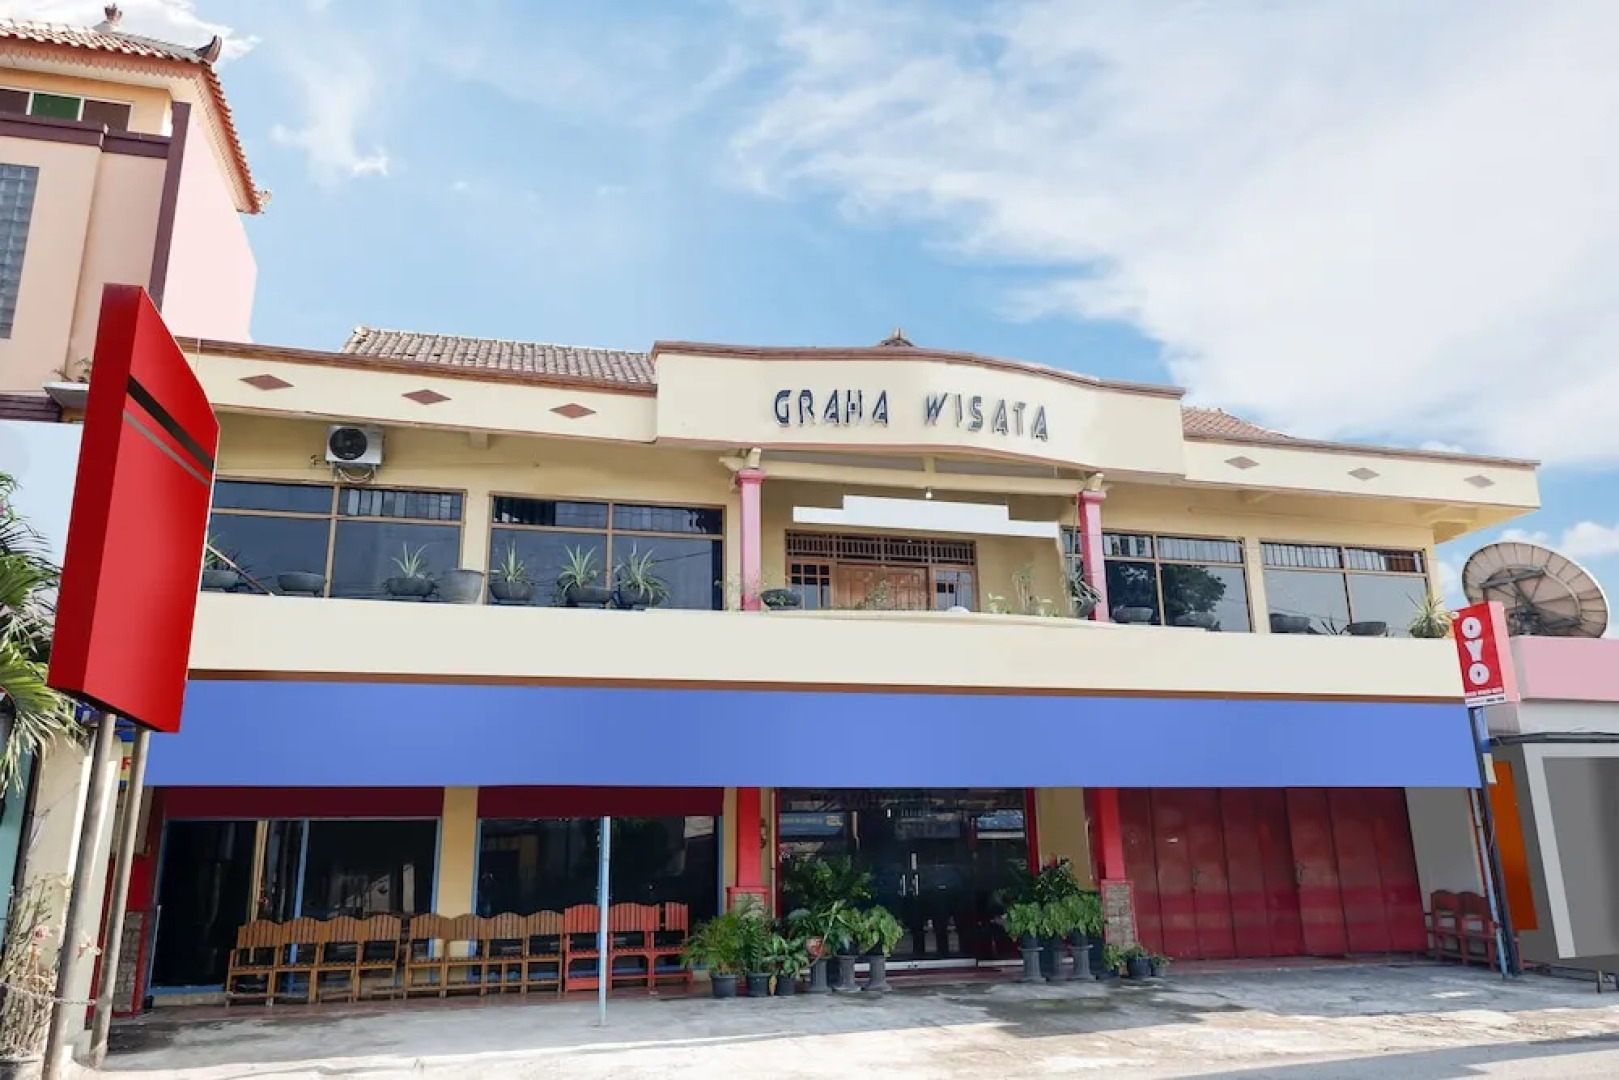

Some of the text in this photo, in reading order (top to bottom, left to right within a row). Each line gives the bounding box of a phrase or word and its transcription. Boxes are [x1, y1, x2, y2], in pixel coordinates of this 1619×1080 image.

[774, 389, 1049, 442] GRAHA WISATA
[1461, 616, 1490, 686] OYO
